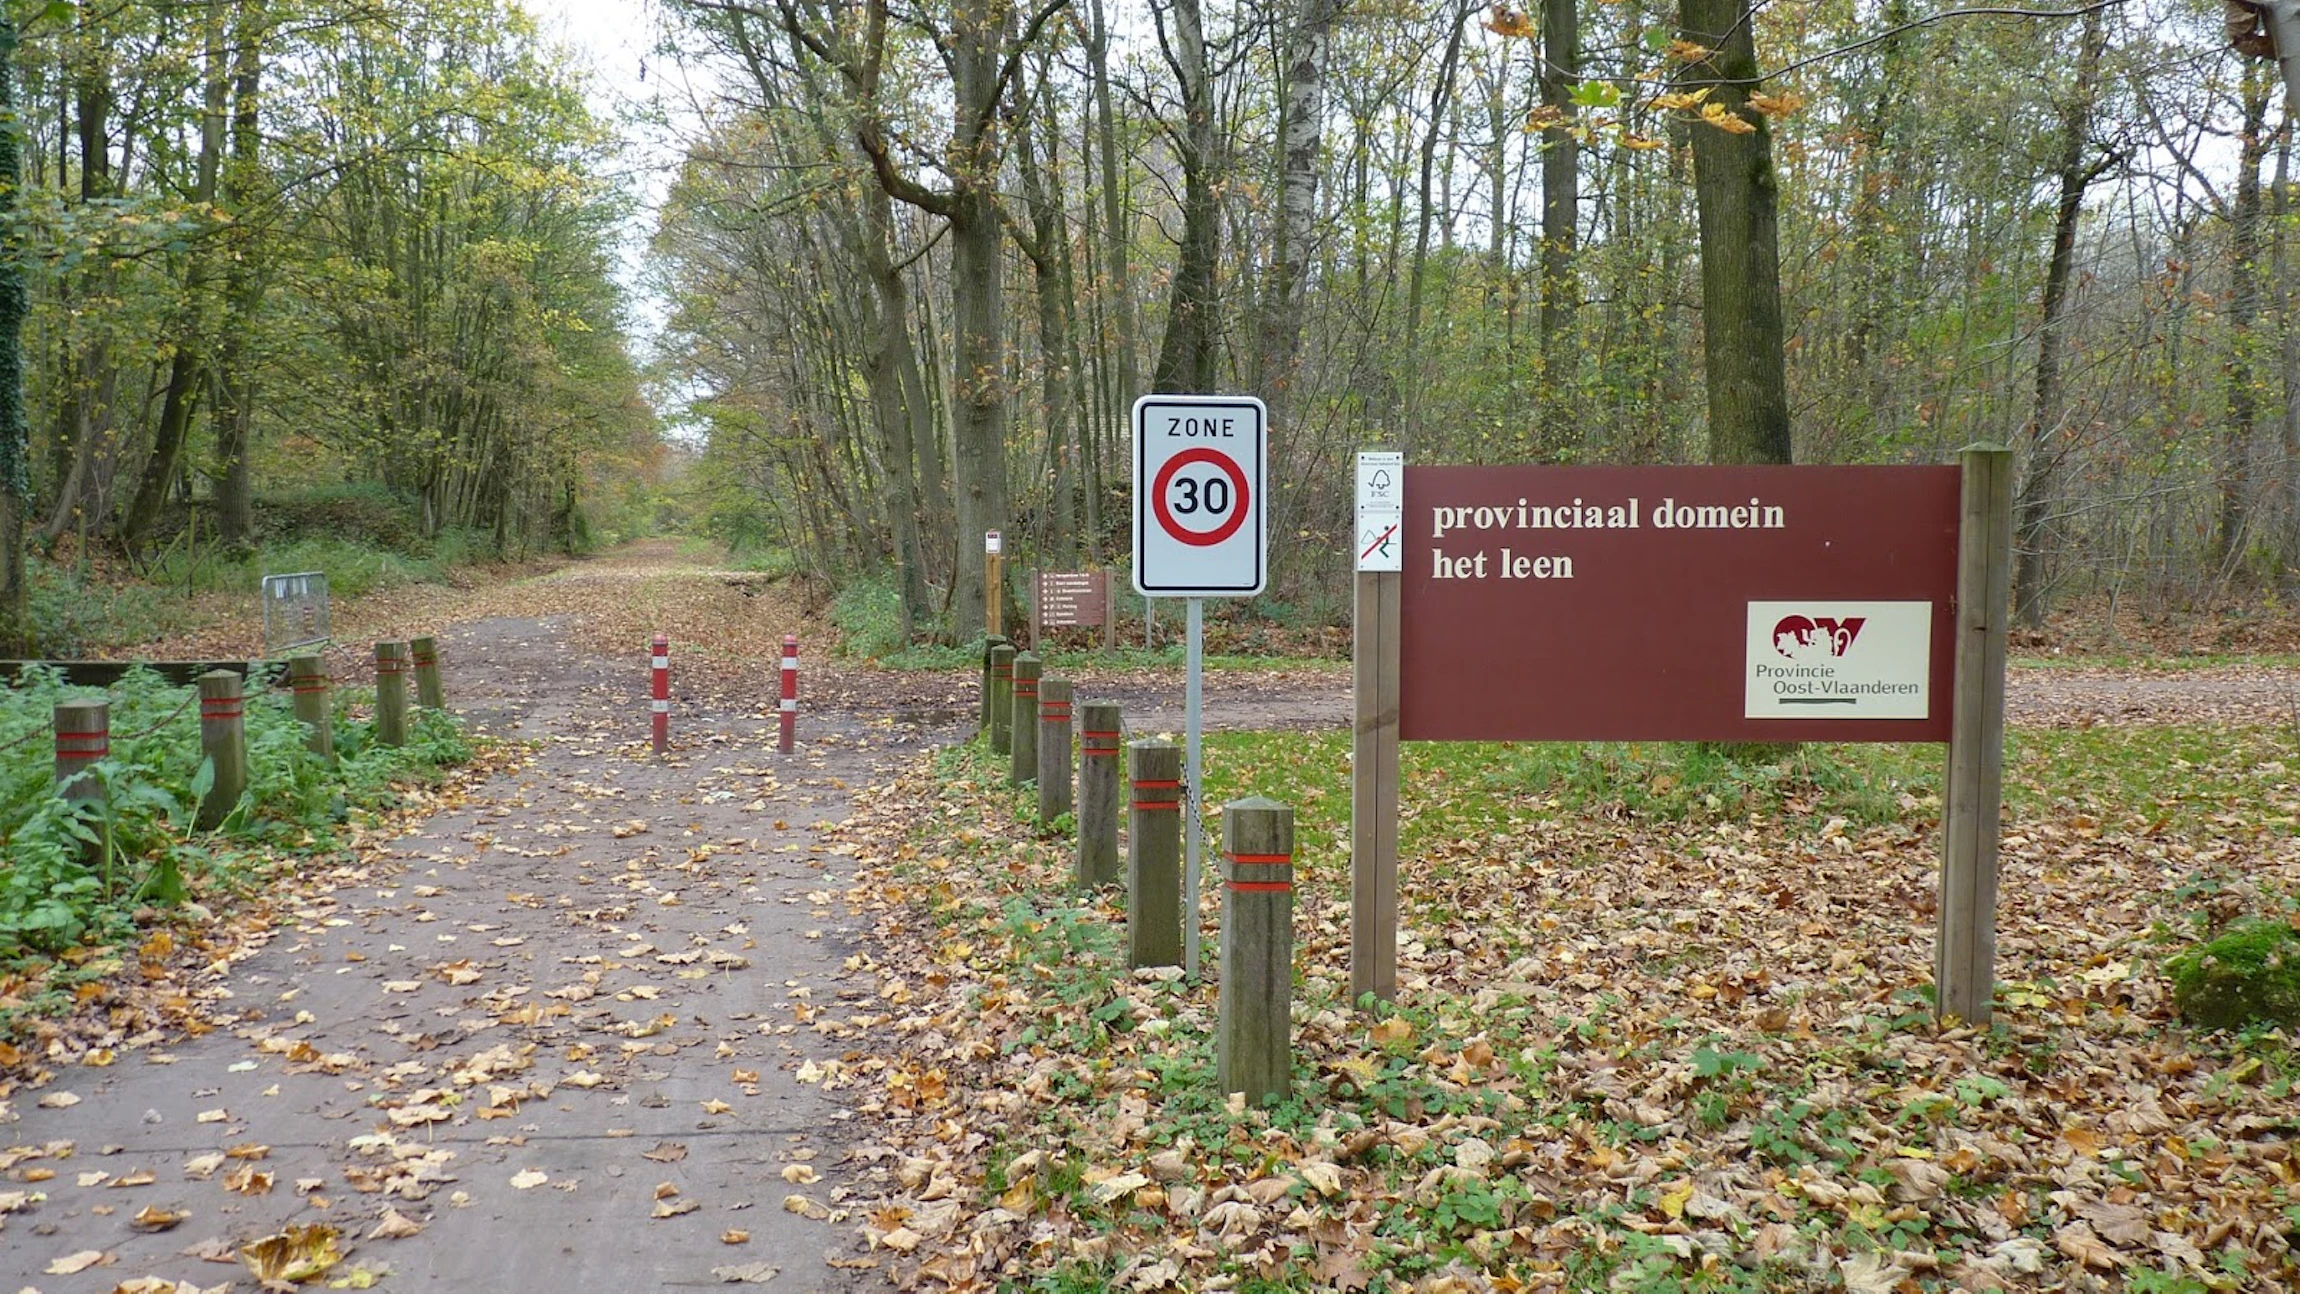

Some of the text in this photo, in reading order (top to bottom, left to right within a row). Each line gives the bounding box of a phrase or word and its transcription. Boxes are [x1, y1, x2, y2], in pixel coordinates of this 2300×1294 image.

[1167, 417, 1235, 438] ZONE
[1173, 477, 1229, 515] 30
[1431, 497, 1785, 538] provinciaal domein
[1431, 548, 1574, 579] het leen
[1755, 663, 1835, 678] Provincie
[1772, 680, 1919, 695] Oost-Vlaanderen
